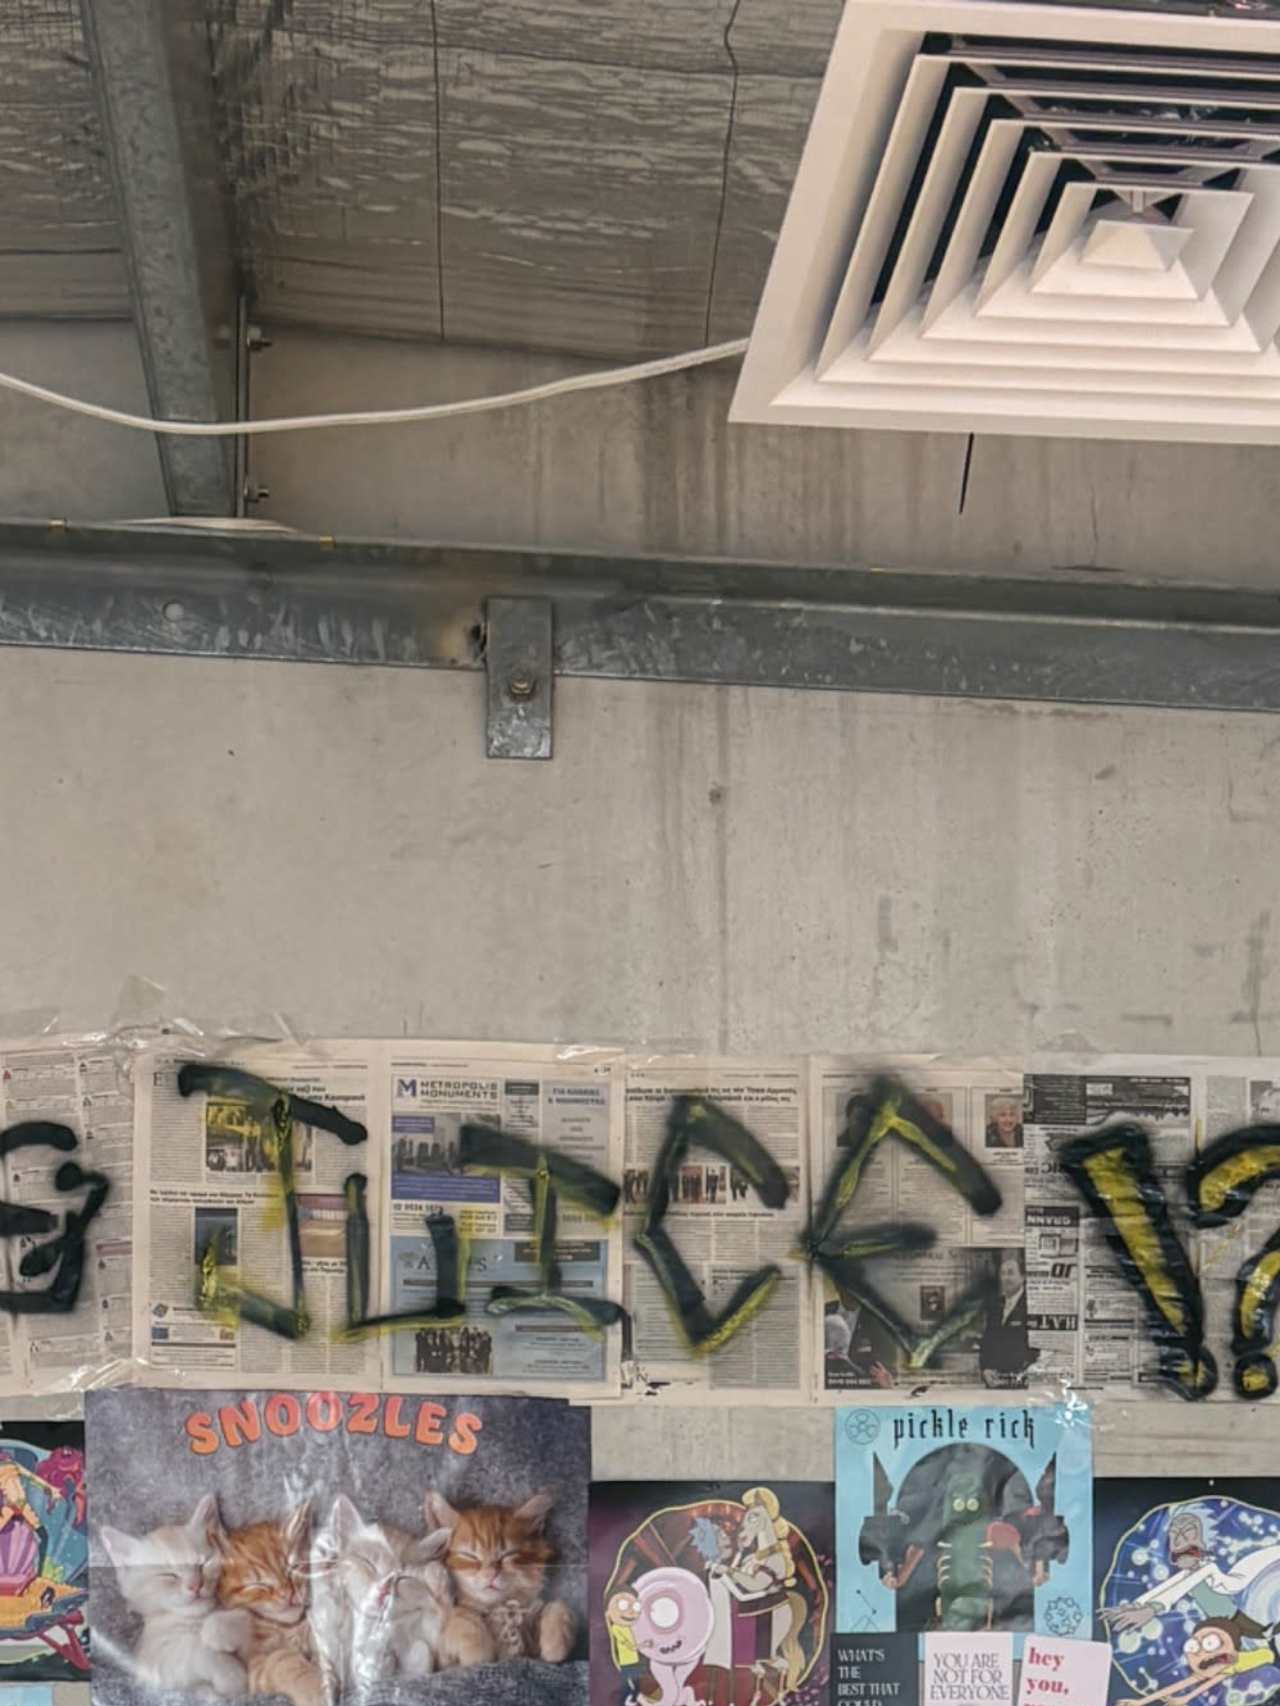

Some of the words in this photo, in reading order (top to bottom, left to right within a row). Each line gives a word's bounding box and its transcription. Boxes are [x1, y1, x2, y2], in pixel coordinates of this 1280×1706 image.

[420, 1080, 498, 1091] METROPOLIS
[420, 1089, 498, 1100] MONUMENTS
[176, 1065, 1002, 1368] JUICE
[184, 1390, 483, 1456] SNOOZLES
[892, 1410, 969, 1450] pickle
[985, 1410, 1035, 1449] rick
[837, 1649, 885, 1663] WHAT'S
[933, 1653, 970, 1668] YOU
[971, 1652, 1000, 1669] ARE
[1028, 1647, 1065, 1671] hey
[837, 1666, 861, 1679] THE
[933, 1669, 968, 1684] NOT
[970, 1668, 1003, 1684] FOR
[837, 1683, 867, 1696] BEST
[869, 1682, 901, 1696] THAT
[930, 1684, 1010, 1701] EVERYONE
[1026, 1677, 1069, 1695] you,
